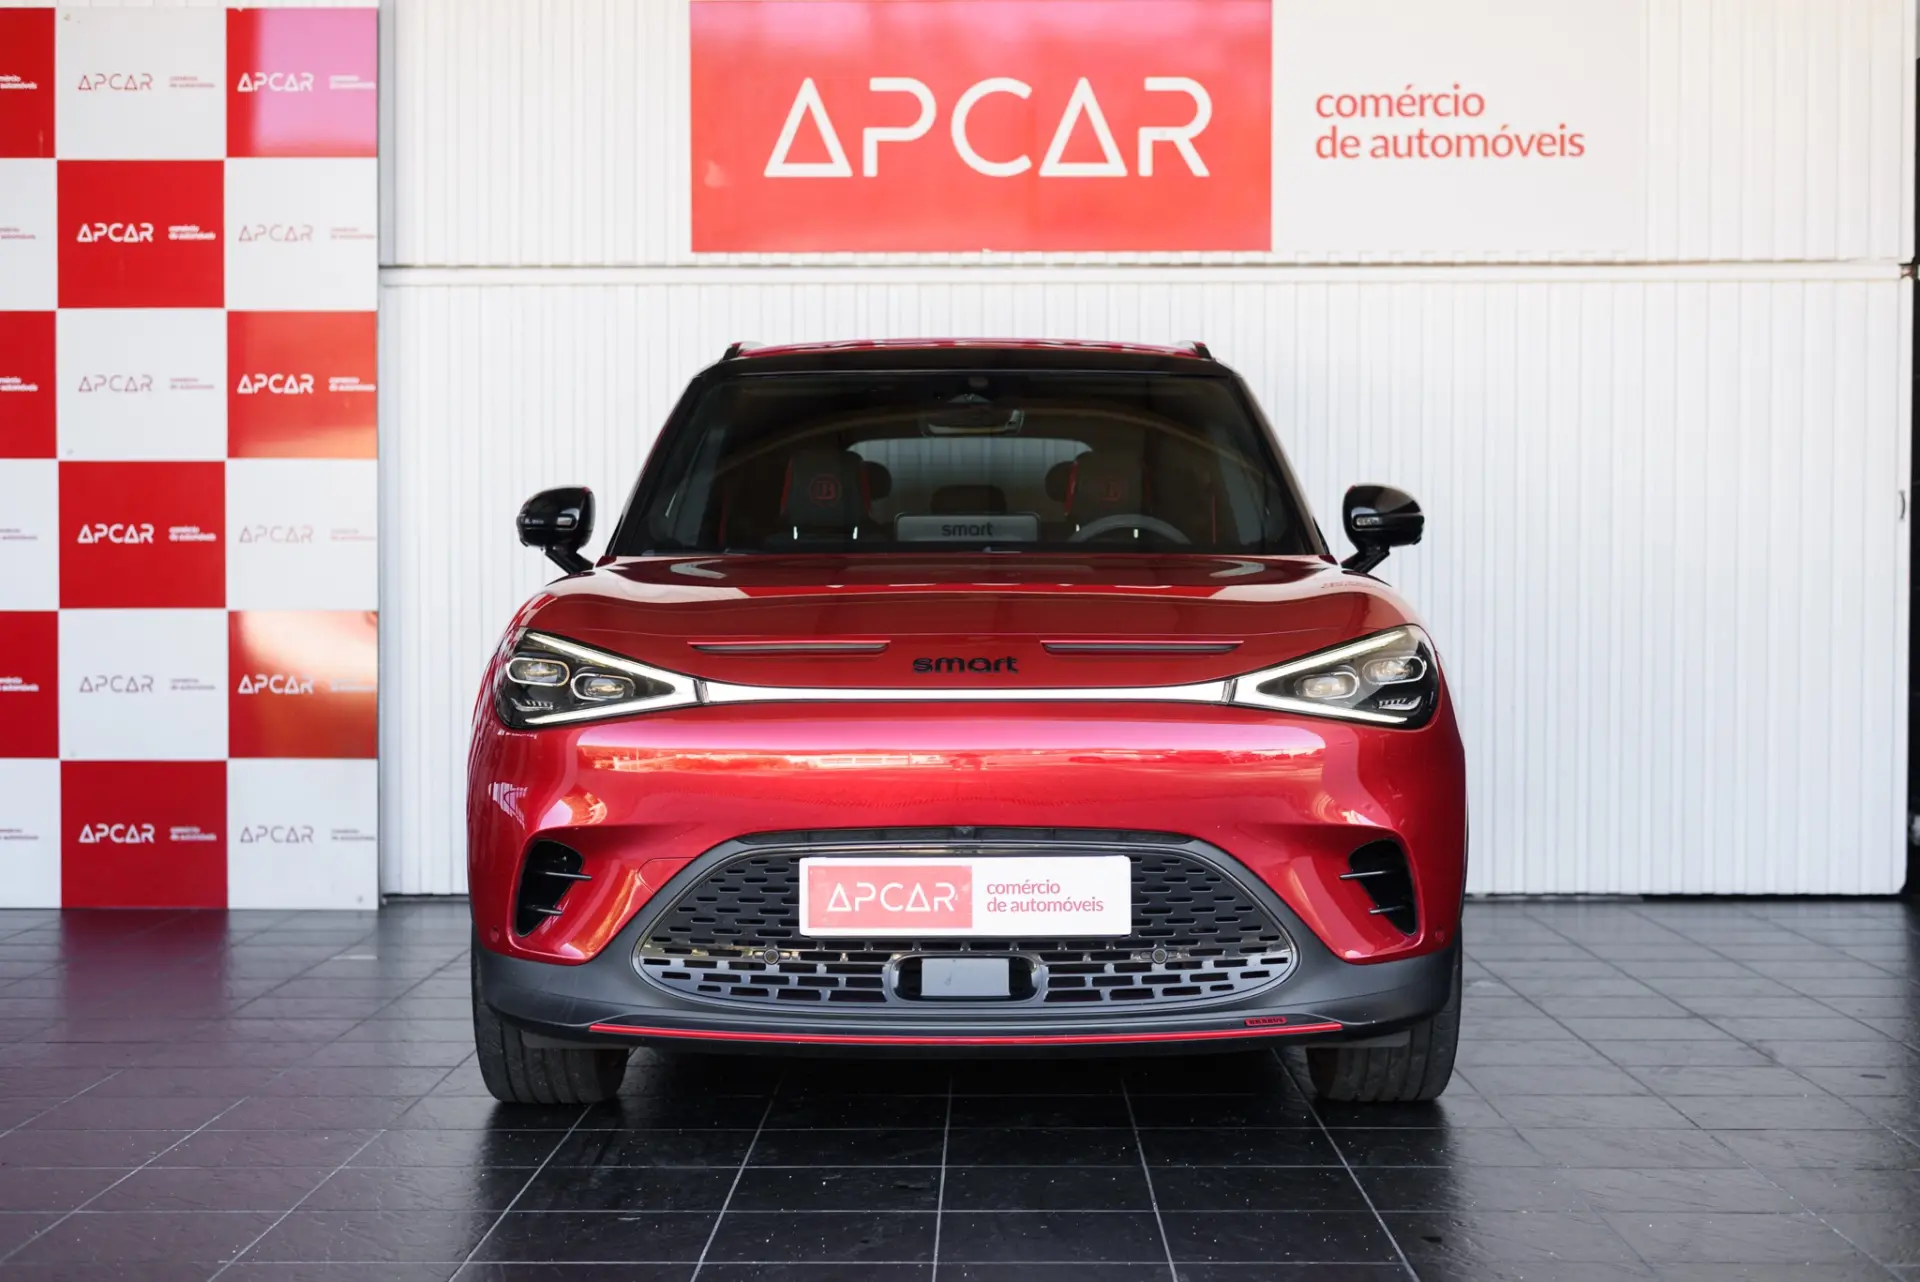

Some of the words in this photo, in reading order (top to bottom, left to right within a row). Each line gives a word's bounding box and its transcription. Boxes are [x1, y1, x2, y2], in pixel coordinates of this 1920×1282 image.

[78, 73, 153, 91] APCAR
[237, 72, 313, 92] APCAR
[1315, 83, 1485, 118] comércio
[763, 77, 1213, 178] APCAR
[1315, 124, 1360, 159] de
[1370, 122, 1586, 159] automóveis
[77, 223, 154, 243] APCAR
[78, 374, 153, 392] APCAR
[237, 374, 314, 394] APCAR
[77, 523, 154, 544] APCAR
[941, 522, 993, 537] smart
[912, 656, 1019, 674] smart
[79, 675, 154, 693] APCAR
[238, 674, 314, 694] APCAR
[79, 823, 155, 843] APCAR
[240, 825, 314, 843] APCAR
[986, 878, 1061, 895] comércio
[827, 882, 956, 912] APCAR
[986, 897, 1006, 913] de
[1010, 896, 1104, 913] automóveis
